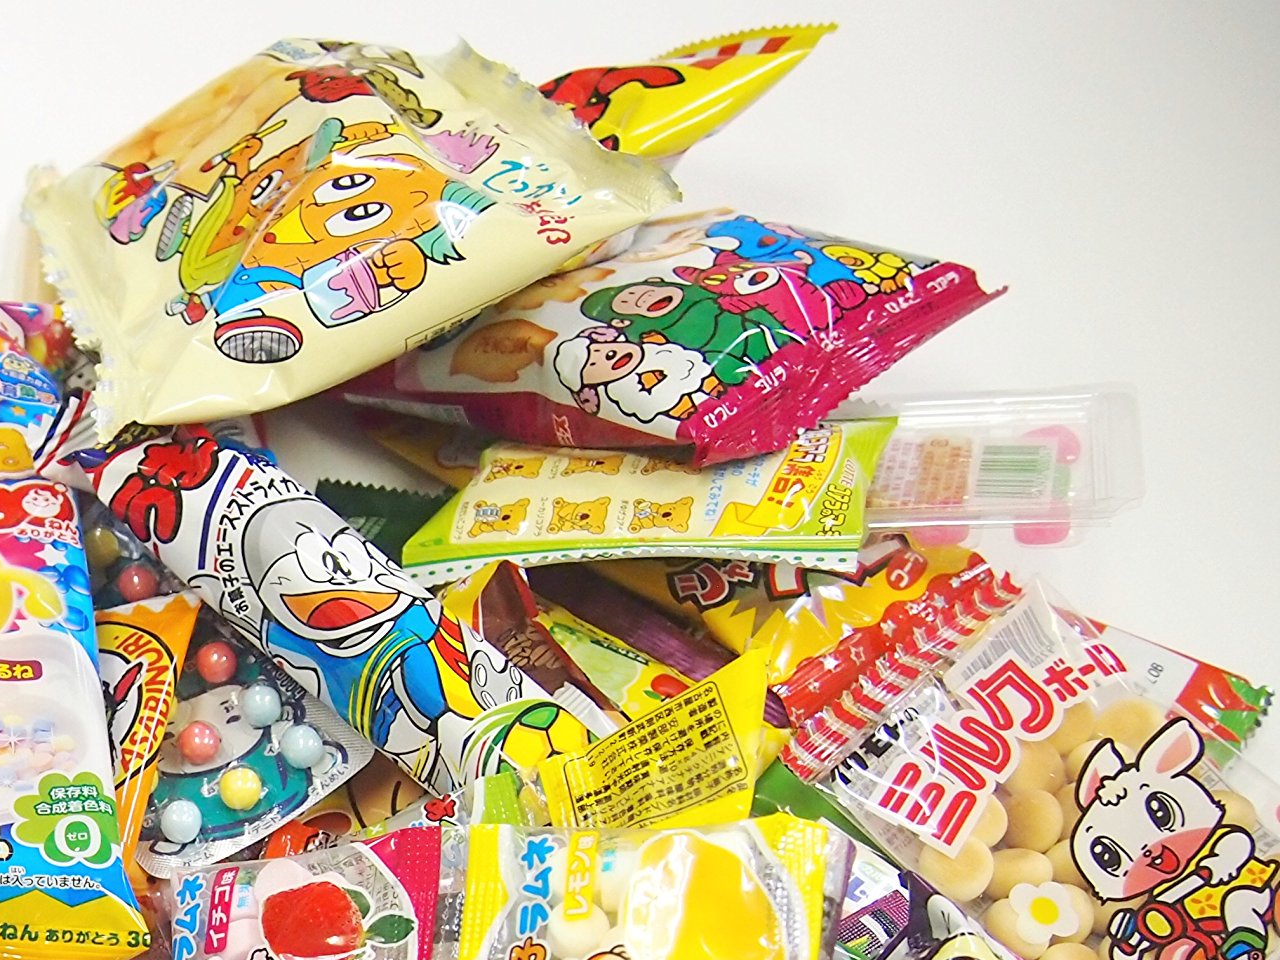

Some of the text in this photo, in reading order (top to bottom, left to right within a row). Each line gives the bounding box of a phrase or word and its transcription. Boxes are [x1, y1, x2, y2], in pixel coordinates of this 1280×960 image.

[50, 786, 98, 800] 保存料
[35, 800, 114, 816] 合成着色料
[566, 834, 597, 916] レモン味
[207, 869, 237, 946] イチゴ味
[44, 927, 121, 948] ありがとう
